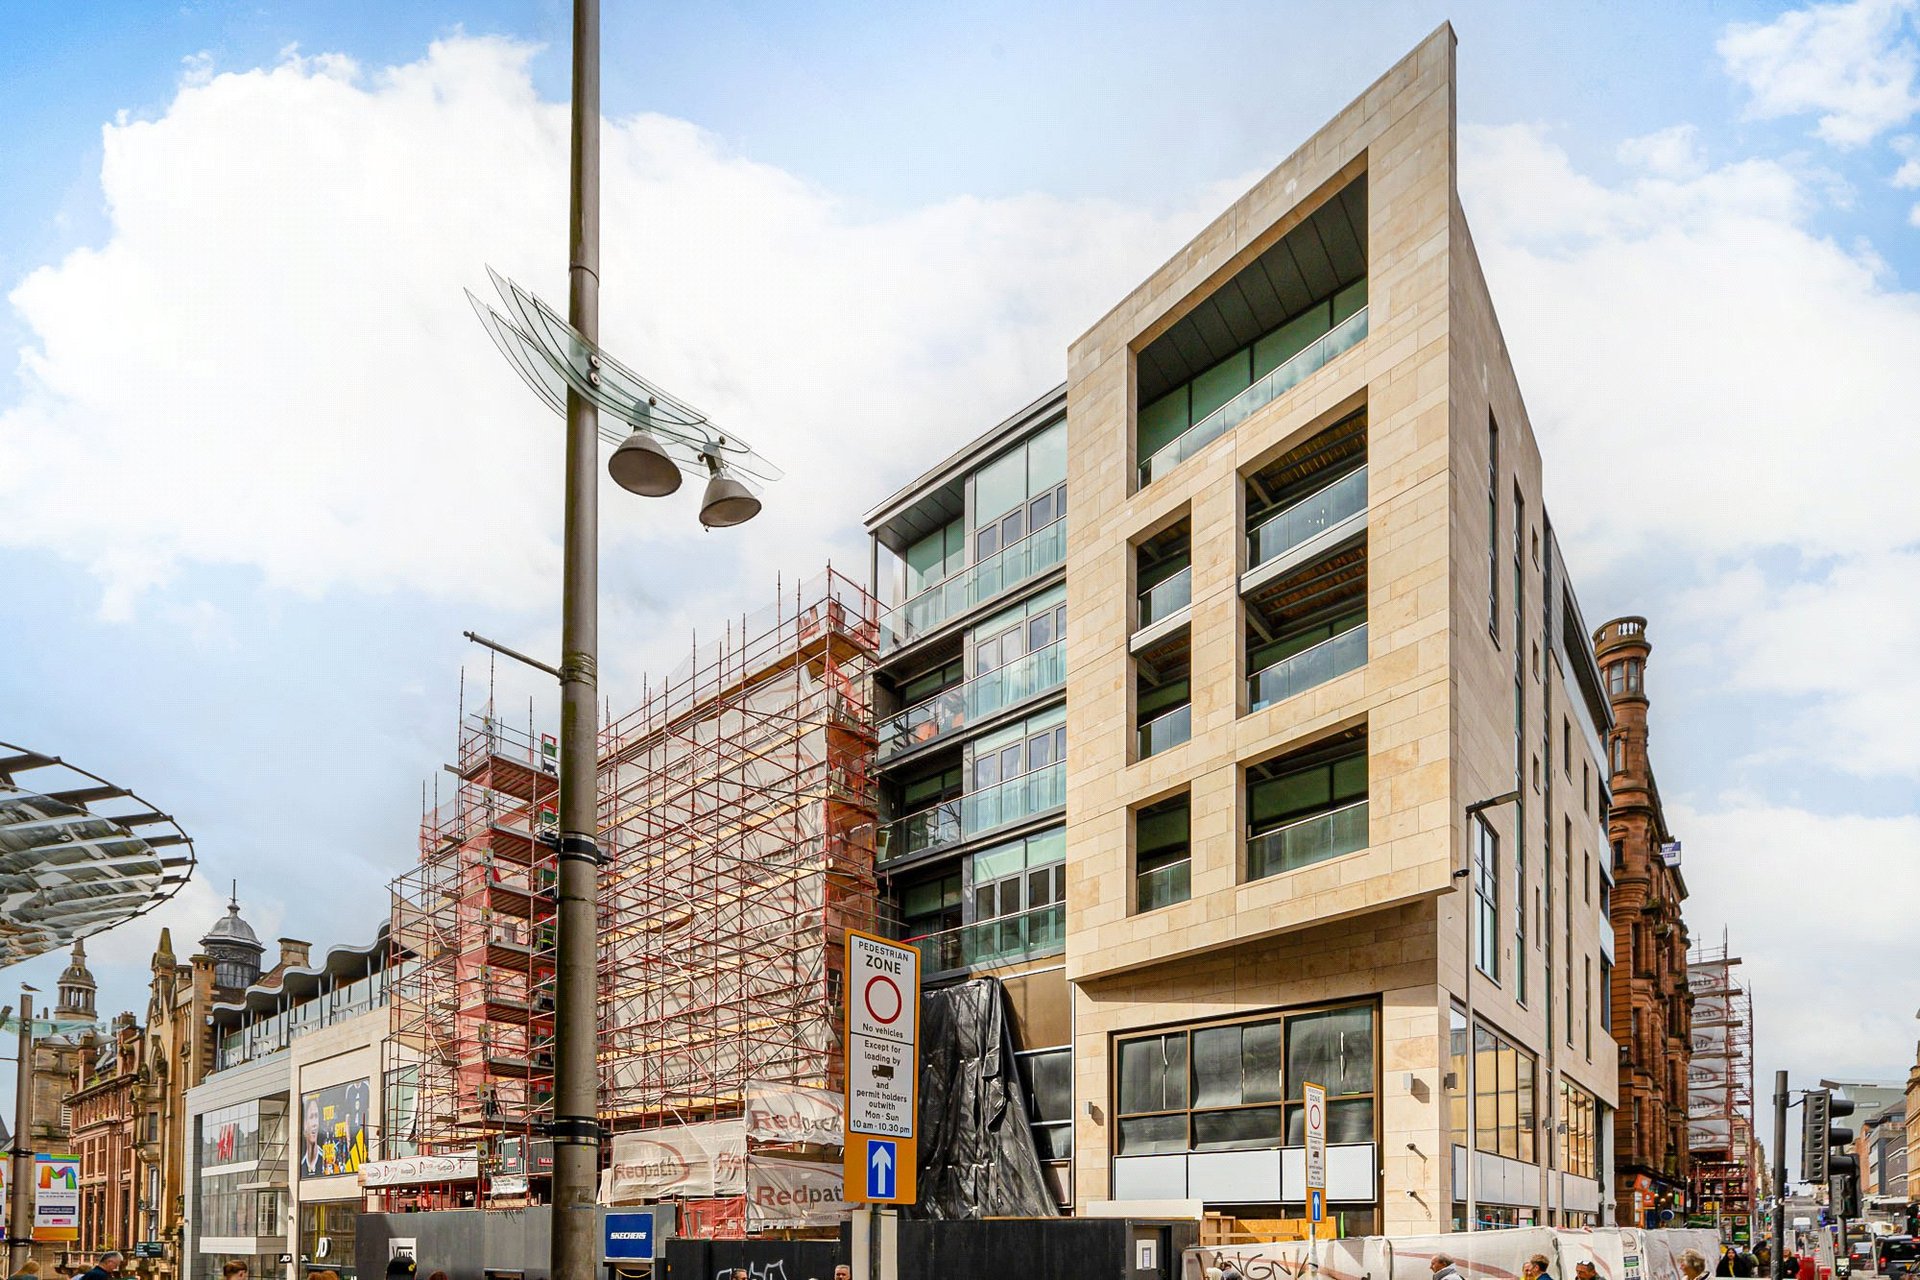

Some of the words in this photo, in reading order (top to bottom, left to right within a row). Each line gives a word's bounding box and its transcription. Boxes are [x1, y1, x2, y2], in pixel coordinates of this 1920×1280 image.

[859, 941, 909, 961] PEDESTRIAN
[866, 954, 901, 975] ZONE
[862, 1023, 873, 1032] No
[875, 1026, 903, 1038] vehicles
[864, 1040, 889, 1052] Except
[891, 1045, 901, 1054] for
[864, 1051, 890, 1064] loading
[892, 1057, 901, 1066] by
[876, 1082, 889, 1090] and
[856, 1090, 880, 1099] permit
[882, 1093, 907, 1103] holders
[868, 1101, 895, 1110] outwith
[865, 1110, 880, 1120] Mon
[885, 1113, 899, 1122] Sun
[853, 1120, 861, 1128] 10
[878, 1123, 899, 1132] 10.30
[900, 1126, 910, 1134] pm
[609, 1231, 647, 1240] SKECHERS
